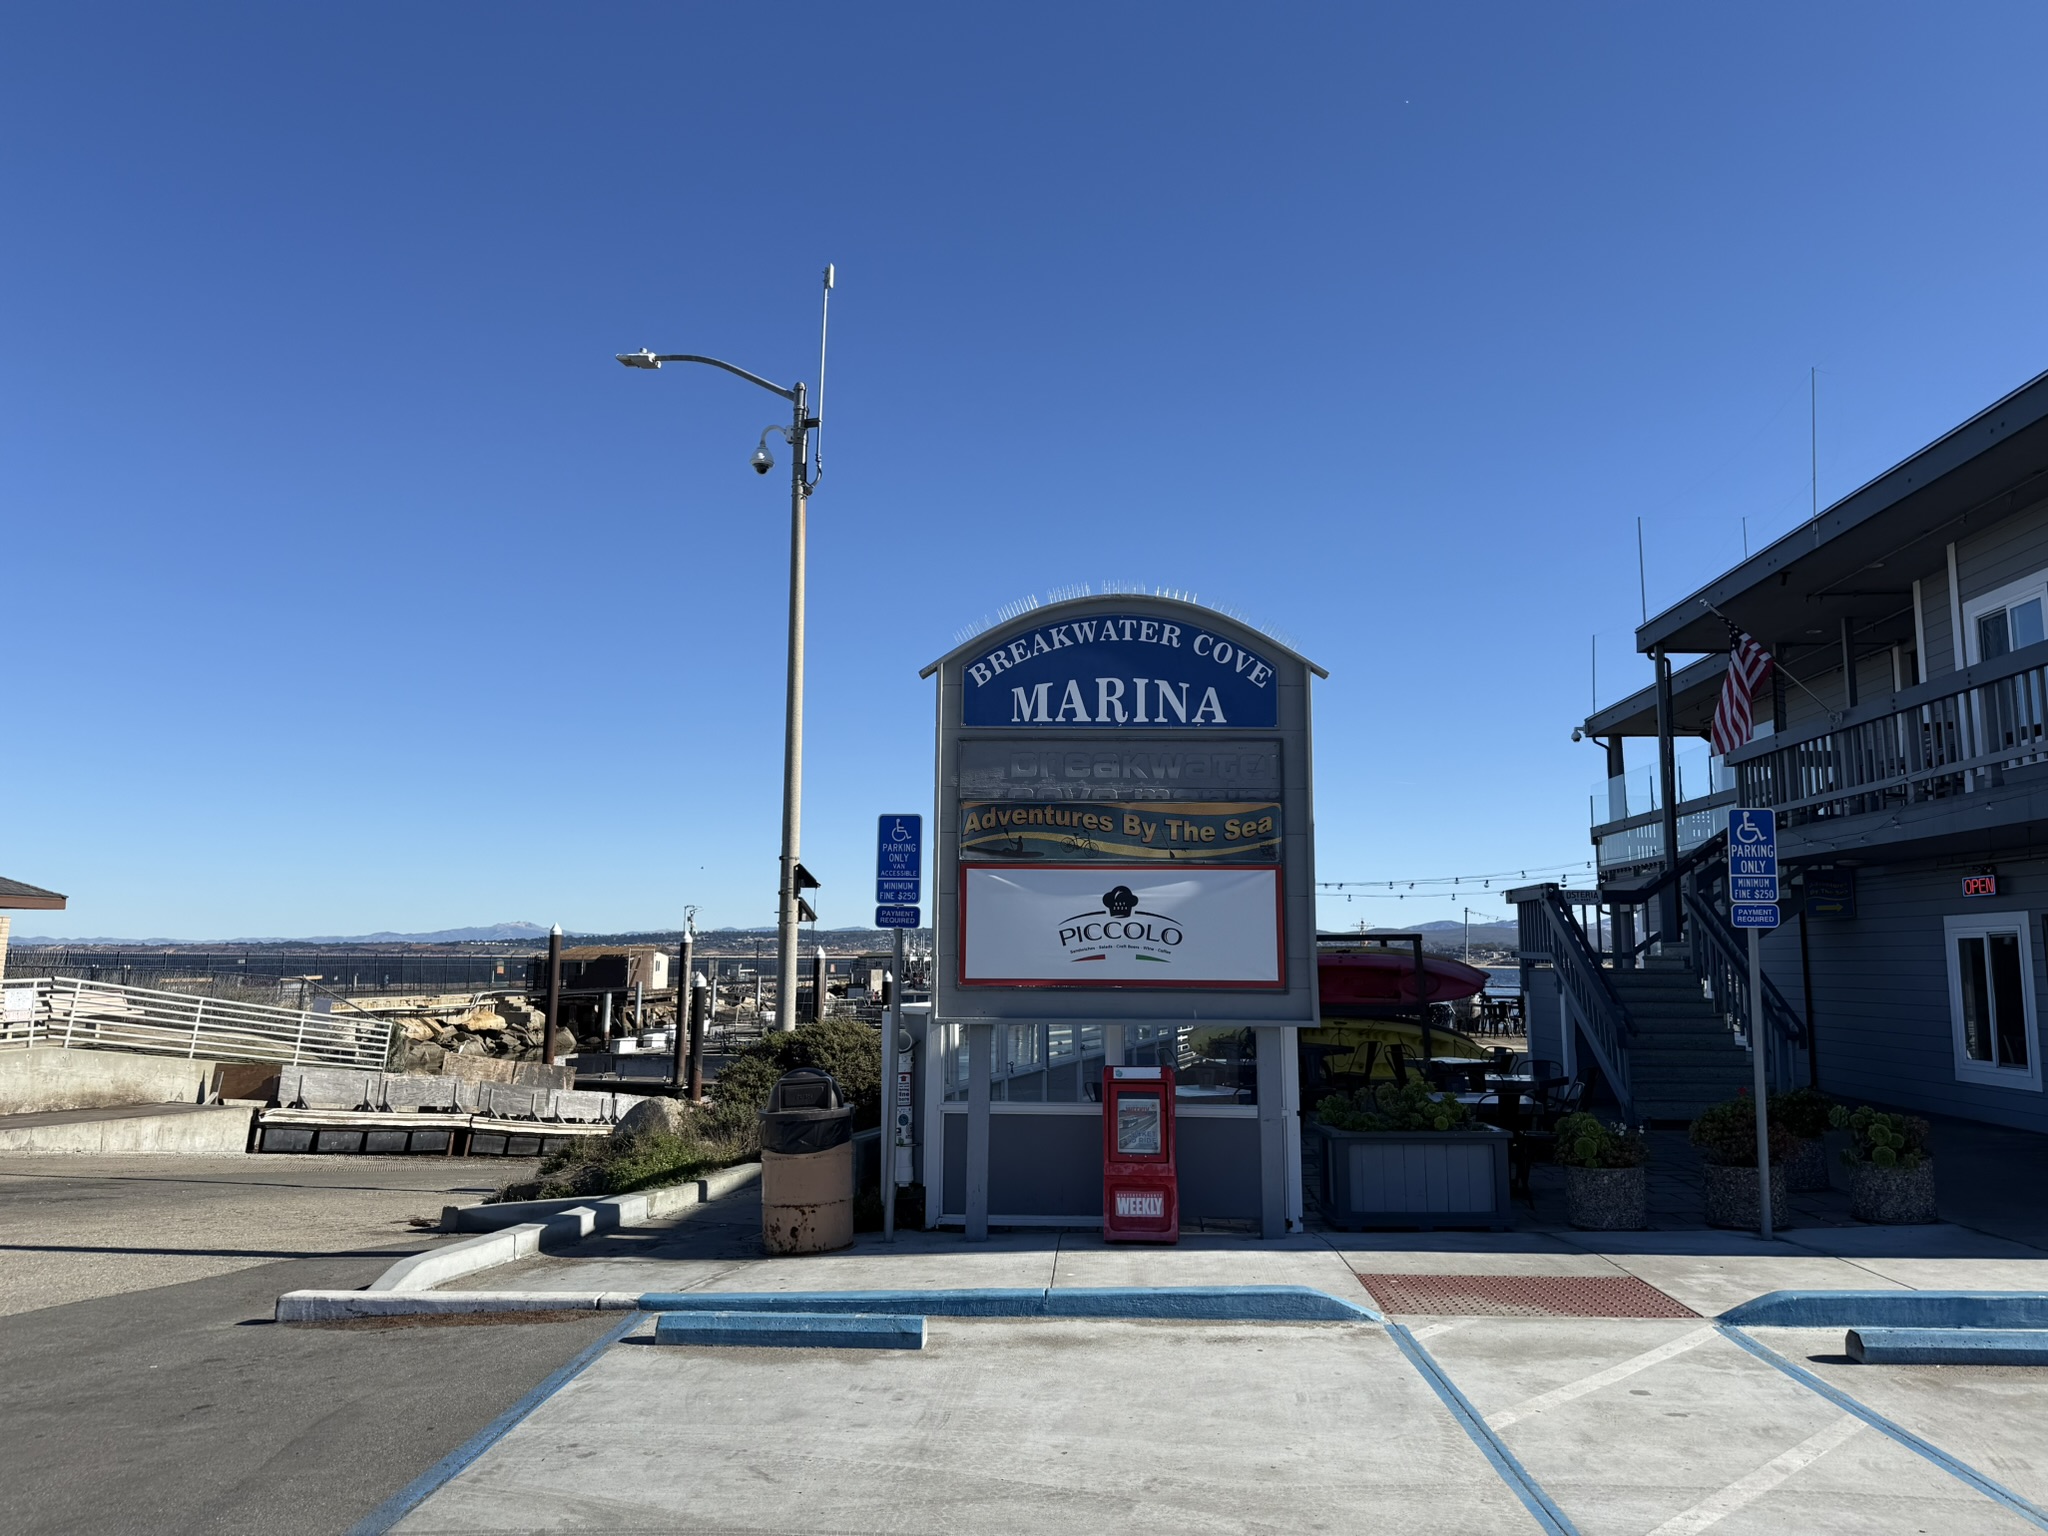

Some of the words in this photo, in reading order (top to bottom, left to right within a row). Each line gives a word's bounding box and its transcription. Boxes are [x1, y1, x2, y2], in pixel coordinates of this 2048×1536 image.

[967, 619, 1181, 688] BREAKWATER
[1193, 634, 1273, 688] COVE
[1011, 677, 1228, 723] MARINA
[962, 805, 1114, 836] Adventures
[1123, 813, 1157, 843] By
[1164, 818, 1216, 842] The
[1224, 815, 1273, 841] Sea
[882, 843, 916, 852] PARKING
[1731, 844, 1774, 858] PARKING
[888, 853, 909, 862] ONLY
[1740, 860, 1766, 874] ONLY
[883, 882, 913, 890] MINIMUM
[1737, 878, 1770, 888] MINIMUM
[1964, 877, 1994, 895] OPEN
[880, 892, 894, 900] FINE
[897, 891, 916, 900] $250
[1566, 891, 1599, 899] OSTERIA
[1734, 889, 1751, 899] FINE
[1754, 889, 1774, 899] $250
[1737, 915, 1775, 923] REQUIRED
[1058, 921, 1183, 947] PICCOLO
[1116, 1197, 1163, 1215] WEEKLY
